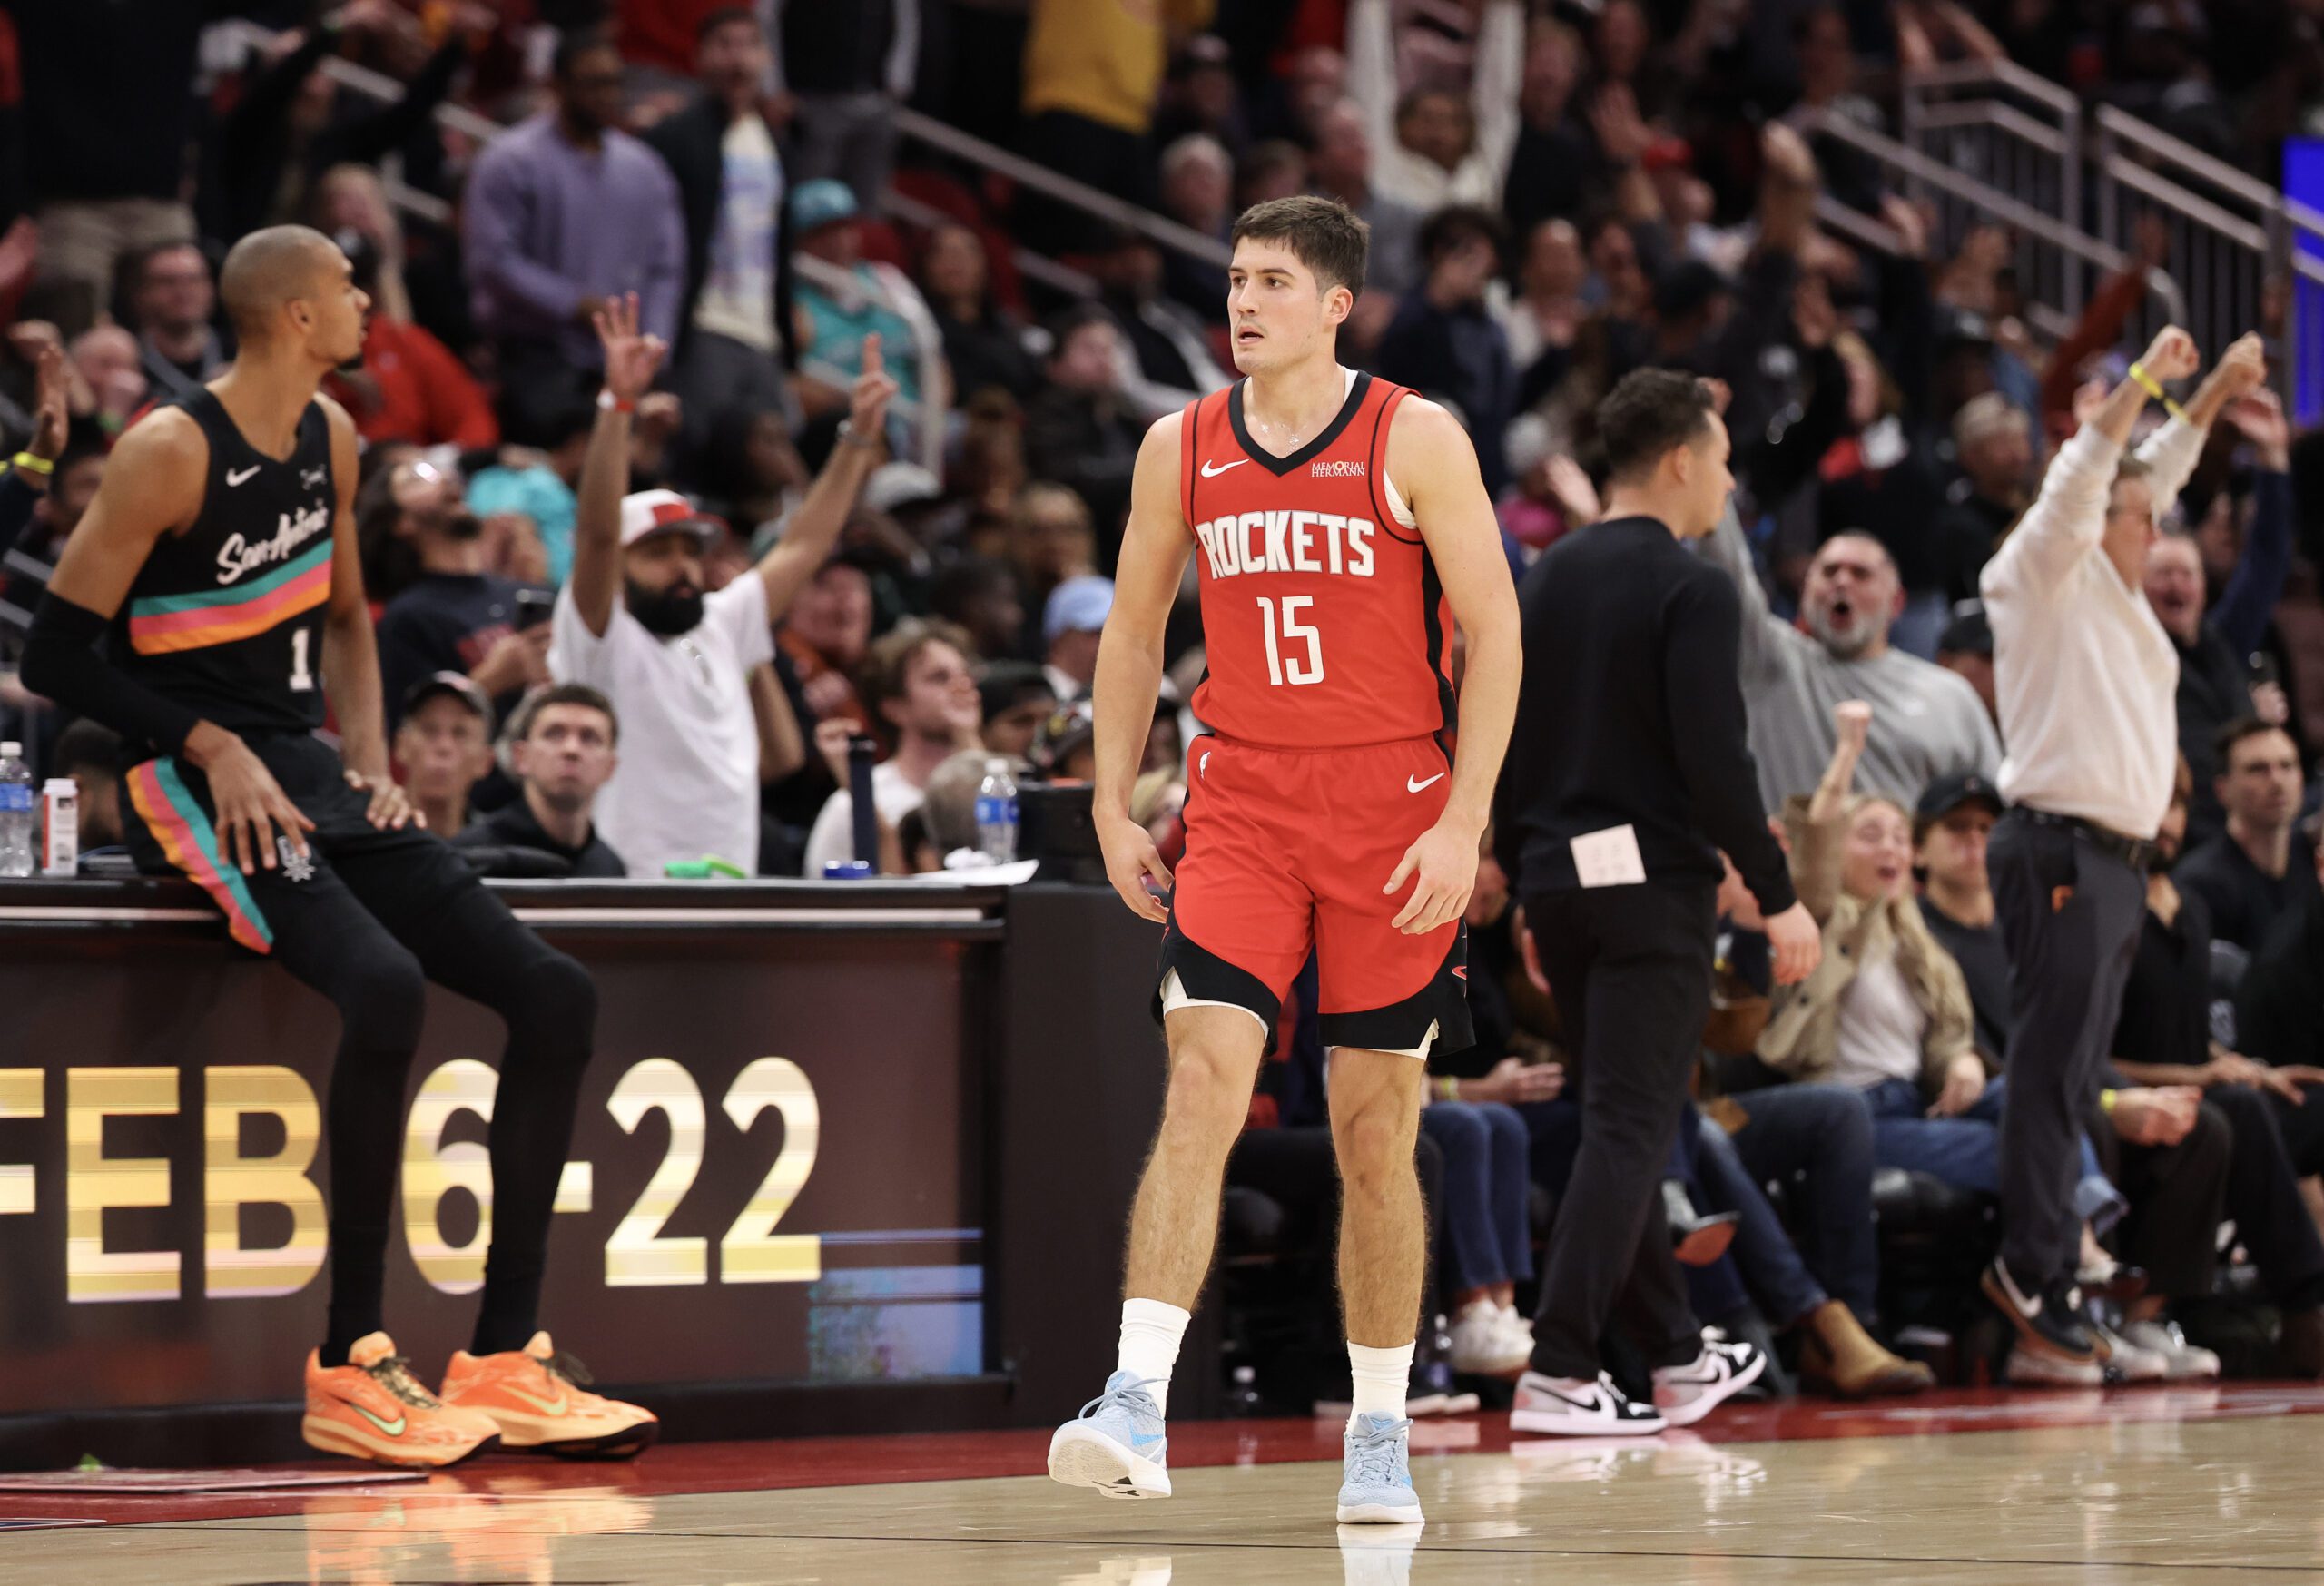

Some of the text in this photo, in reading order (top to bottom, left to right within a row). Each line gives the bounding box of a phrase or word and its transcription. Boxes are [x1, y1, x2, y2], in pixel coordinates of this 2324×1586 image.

[1311, 468, 1365, 477] HERMANN
[1312, 460, 1365, 471] MEMORIAL
[216, 532, 269, 585] San
[1195, 509, 1375, 580] ROCKETS
[290, 627, 313, 691] 1
[1256, 595, 1324, 685] 15
[401, 1057, 821, 1295] 6-22
